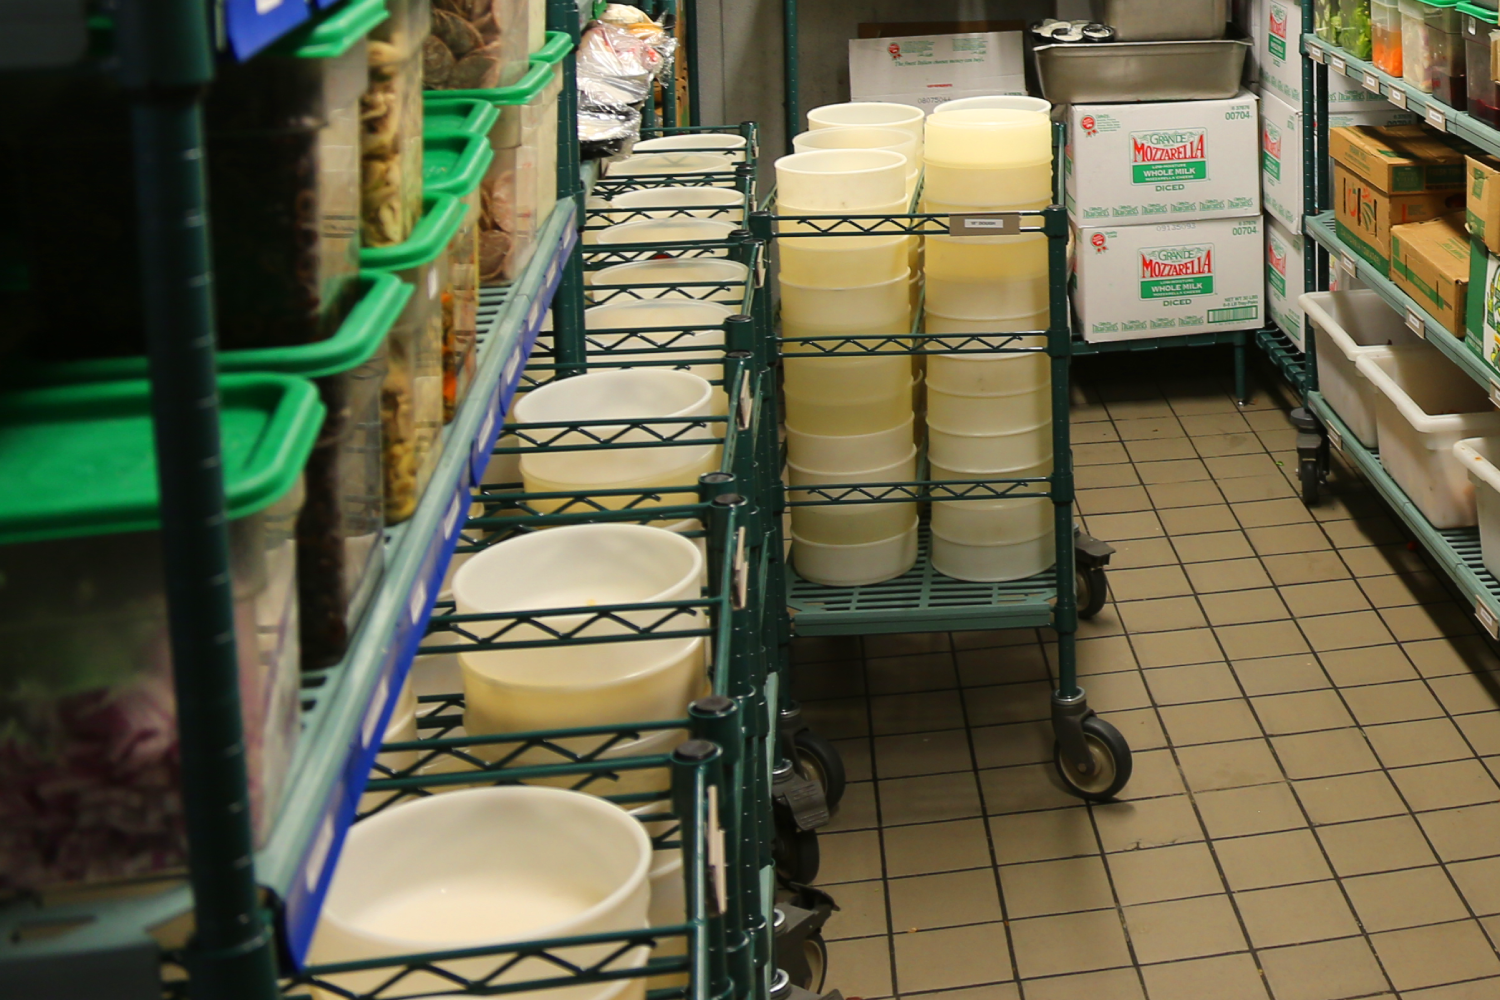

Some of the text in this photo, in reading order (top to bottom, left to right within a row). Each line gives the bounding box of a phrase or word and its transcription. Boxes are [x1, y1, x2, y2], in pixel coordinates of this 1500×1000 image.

[1225, 111, 1250, 120] 00704
[1150, 133, 1186, 145] GRANDE
[1133, 134, 1205, 162] MOZZARELLA
[1143, 169, 1173, 177] WHOLE
[1155, 184, 1185, 192] DICED
[1232, 226, 1257, 235] 00704
[1158, 250, 1194, 261] GRANDE
[1141, 250, 1212, 278] MOZZARELLA
[1151, 283, 1203, 293] WHOLE MILK
